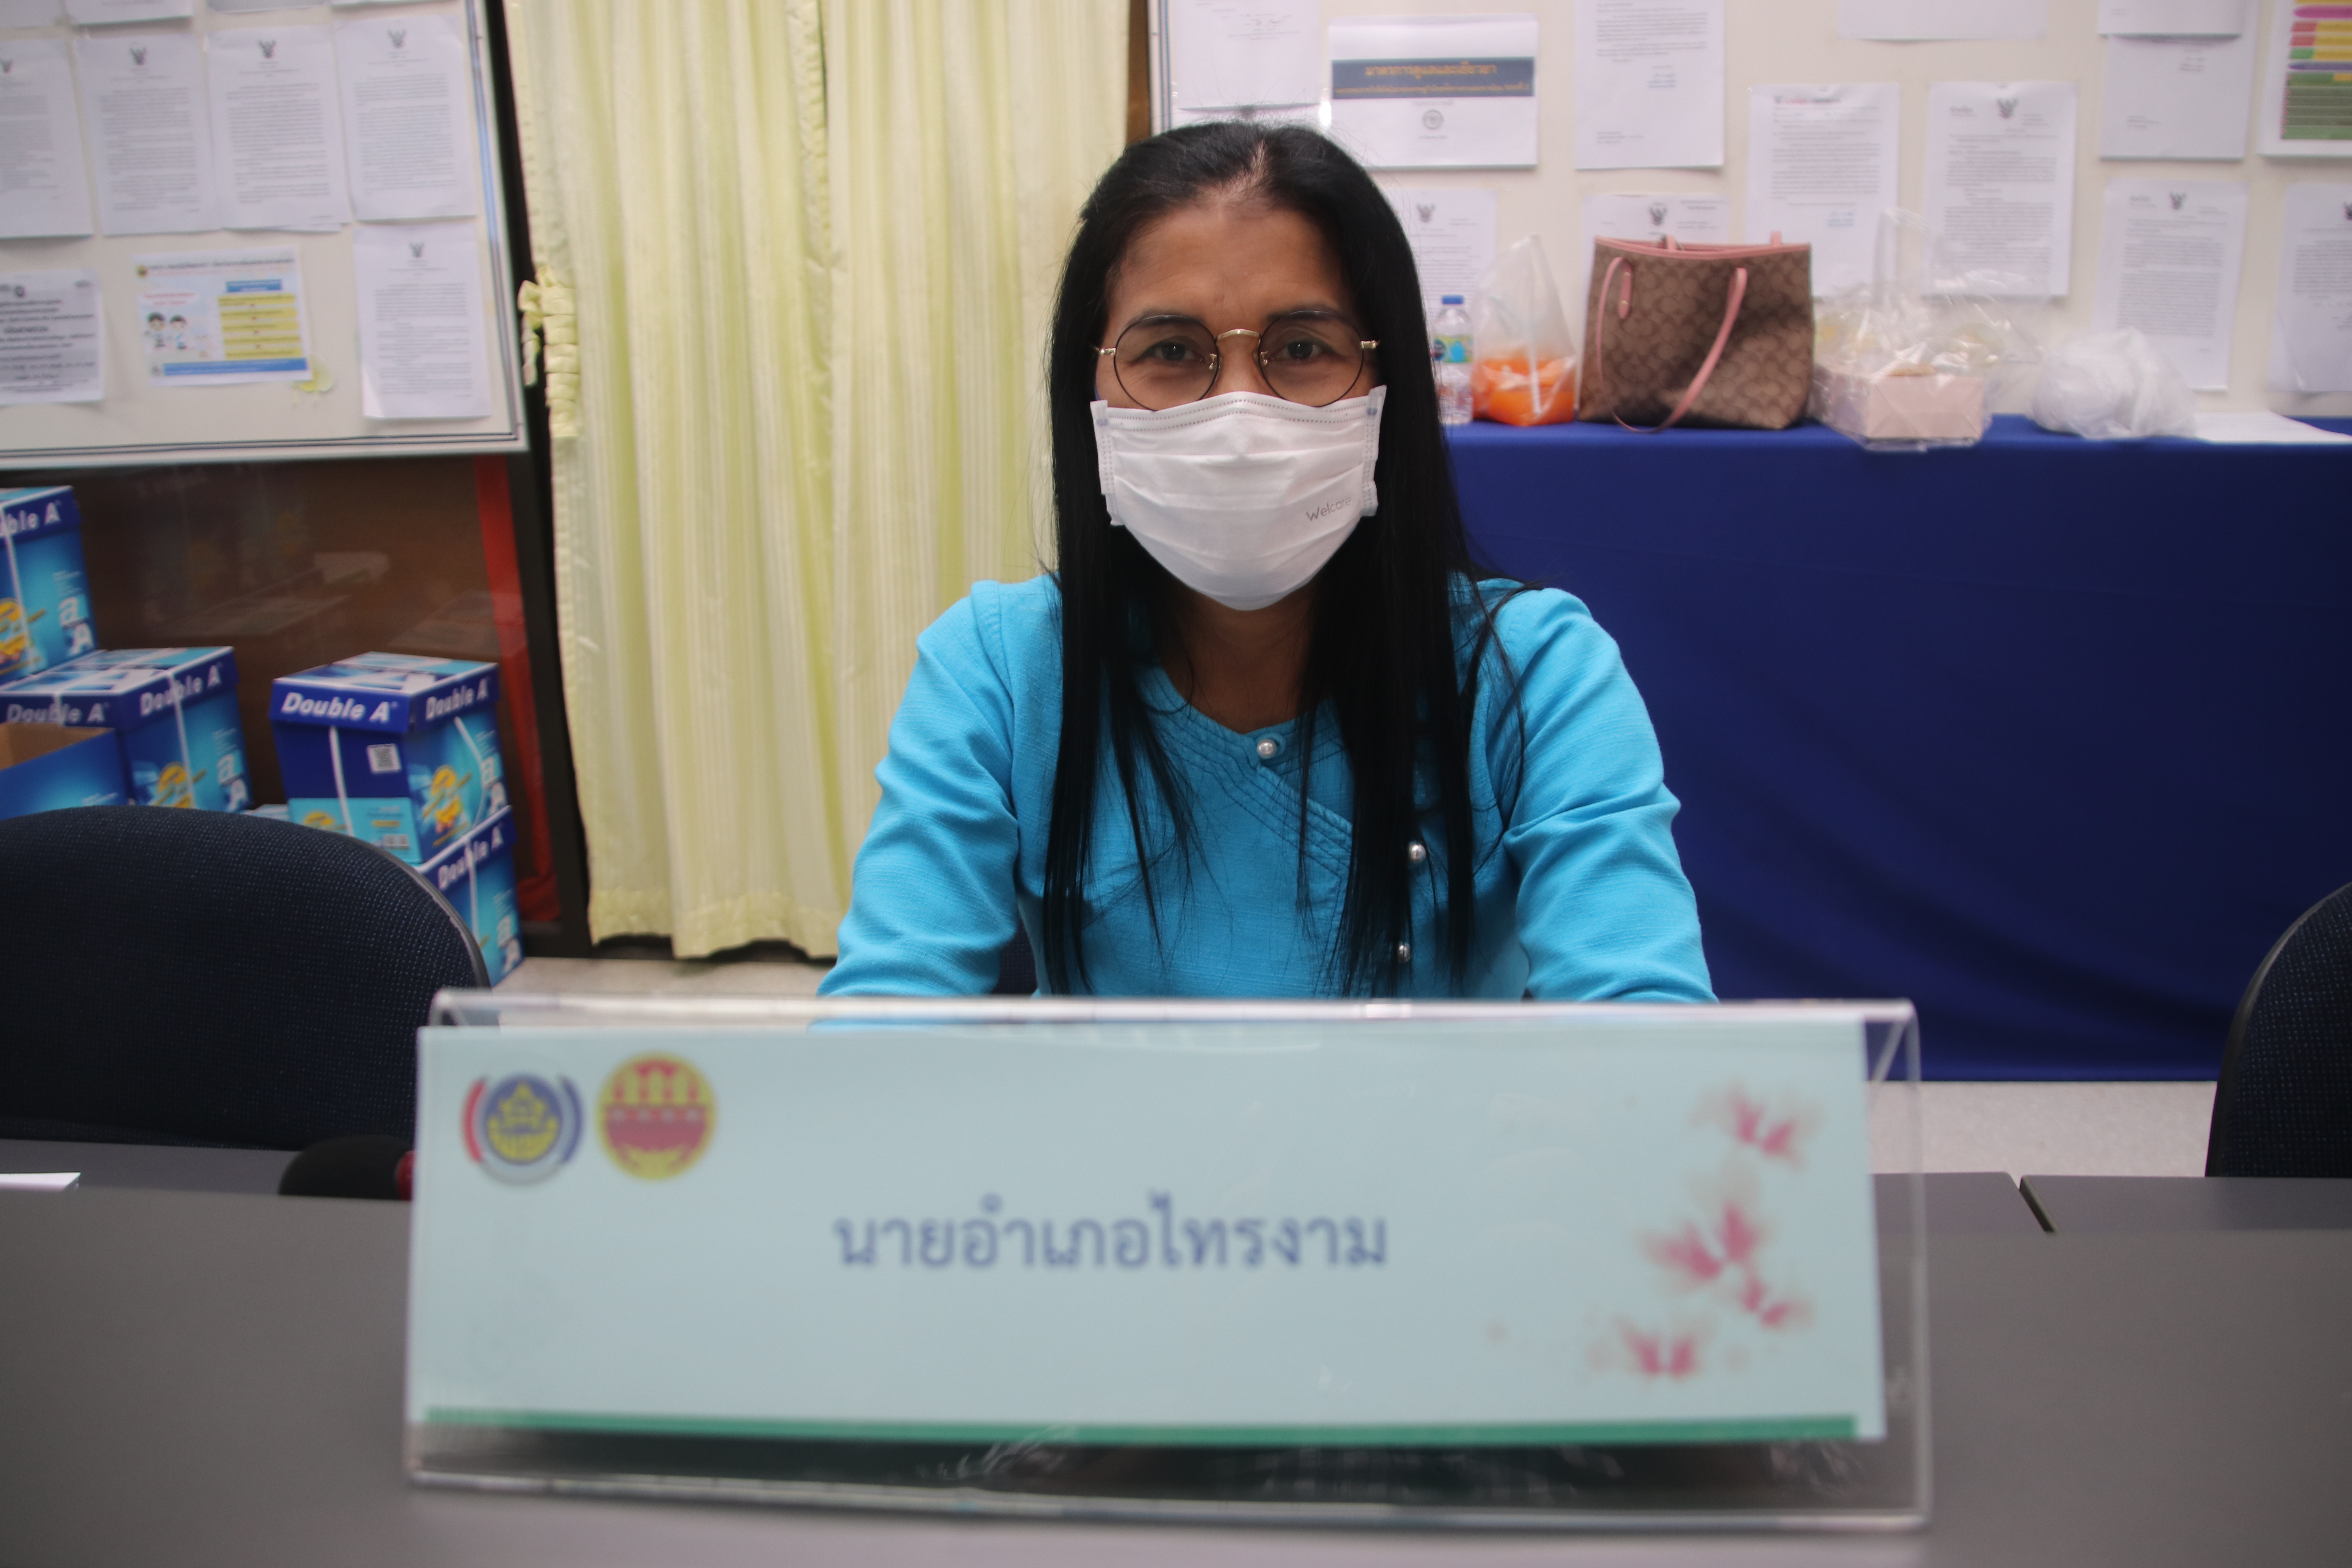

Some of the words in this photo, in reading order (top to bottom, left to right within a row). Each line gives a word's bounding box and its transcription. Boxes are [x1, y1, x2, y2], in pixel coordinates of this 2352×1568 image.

[44, 502, 60, 525] A
[1306, 497, 1351, 521] Welcare
[209, 665, 222, 689] A
[281, 692, 366, 721] Double
[368, 701, 390, 722] A
[425, 685, 475, 720] Double
[476, 678, 489, 701] A
[87, 703, 105, 722] A
[491, 826, 503, 850] A
[833, 1189, 1388, 1269] นายอำเภอไทรงาม
